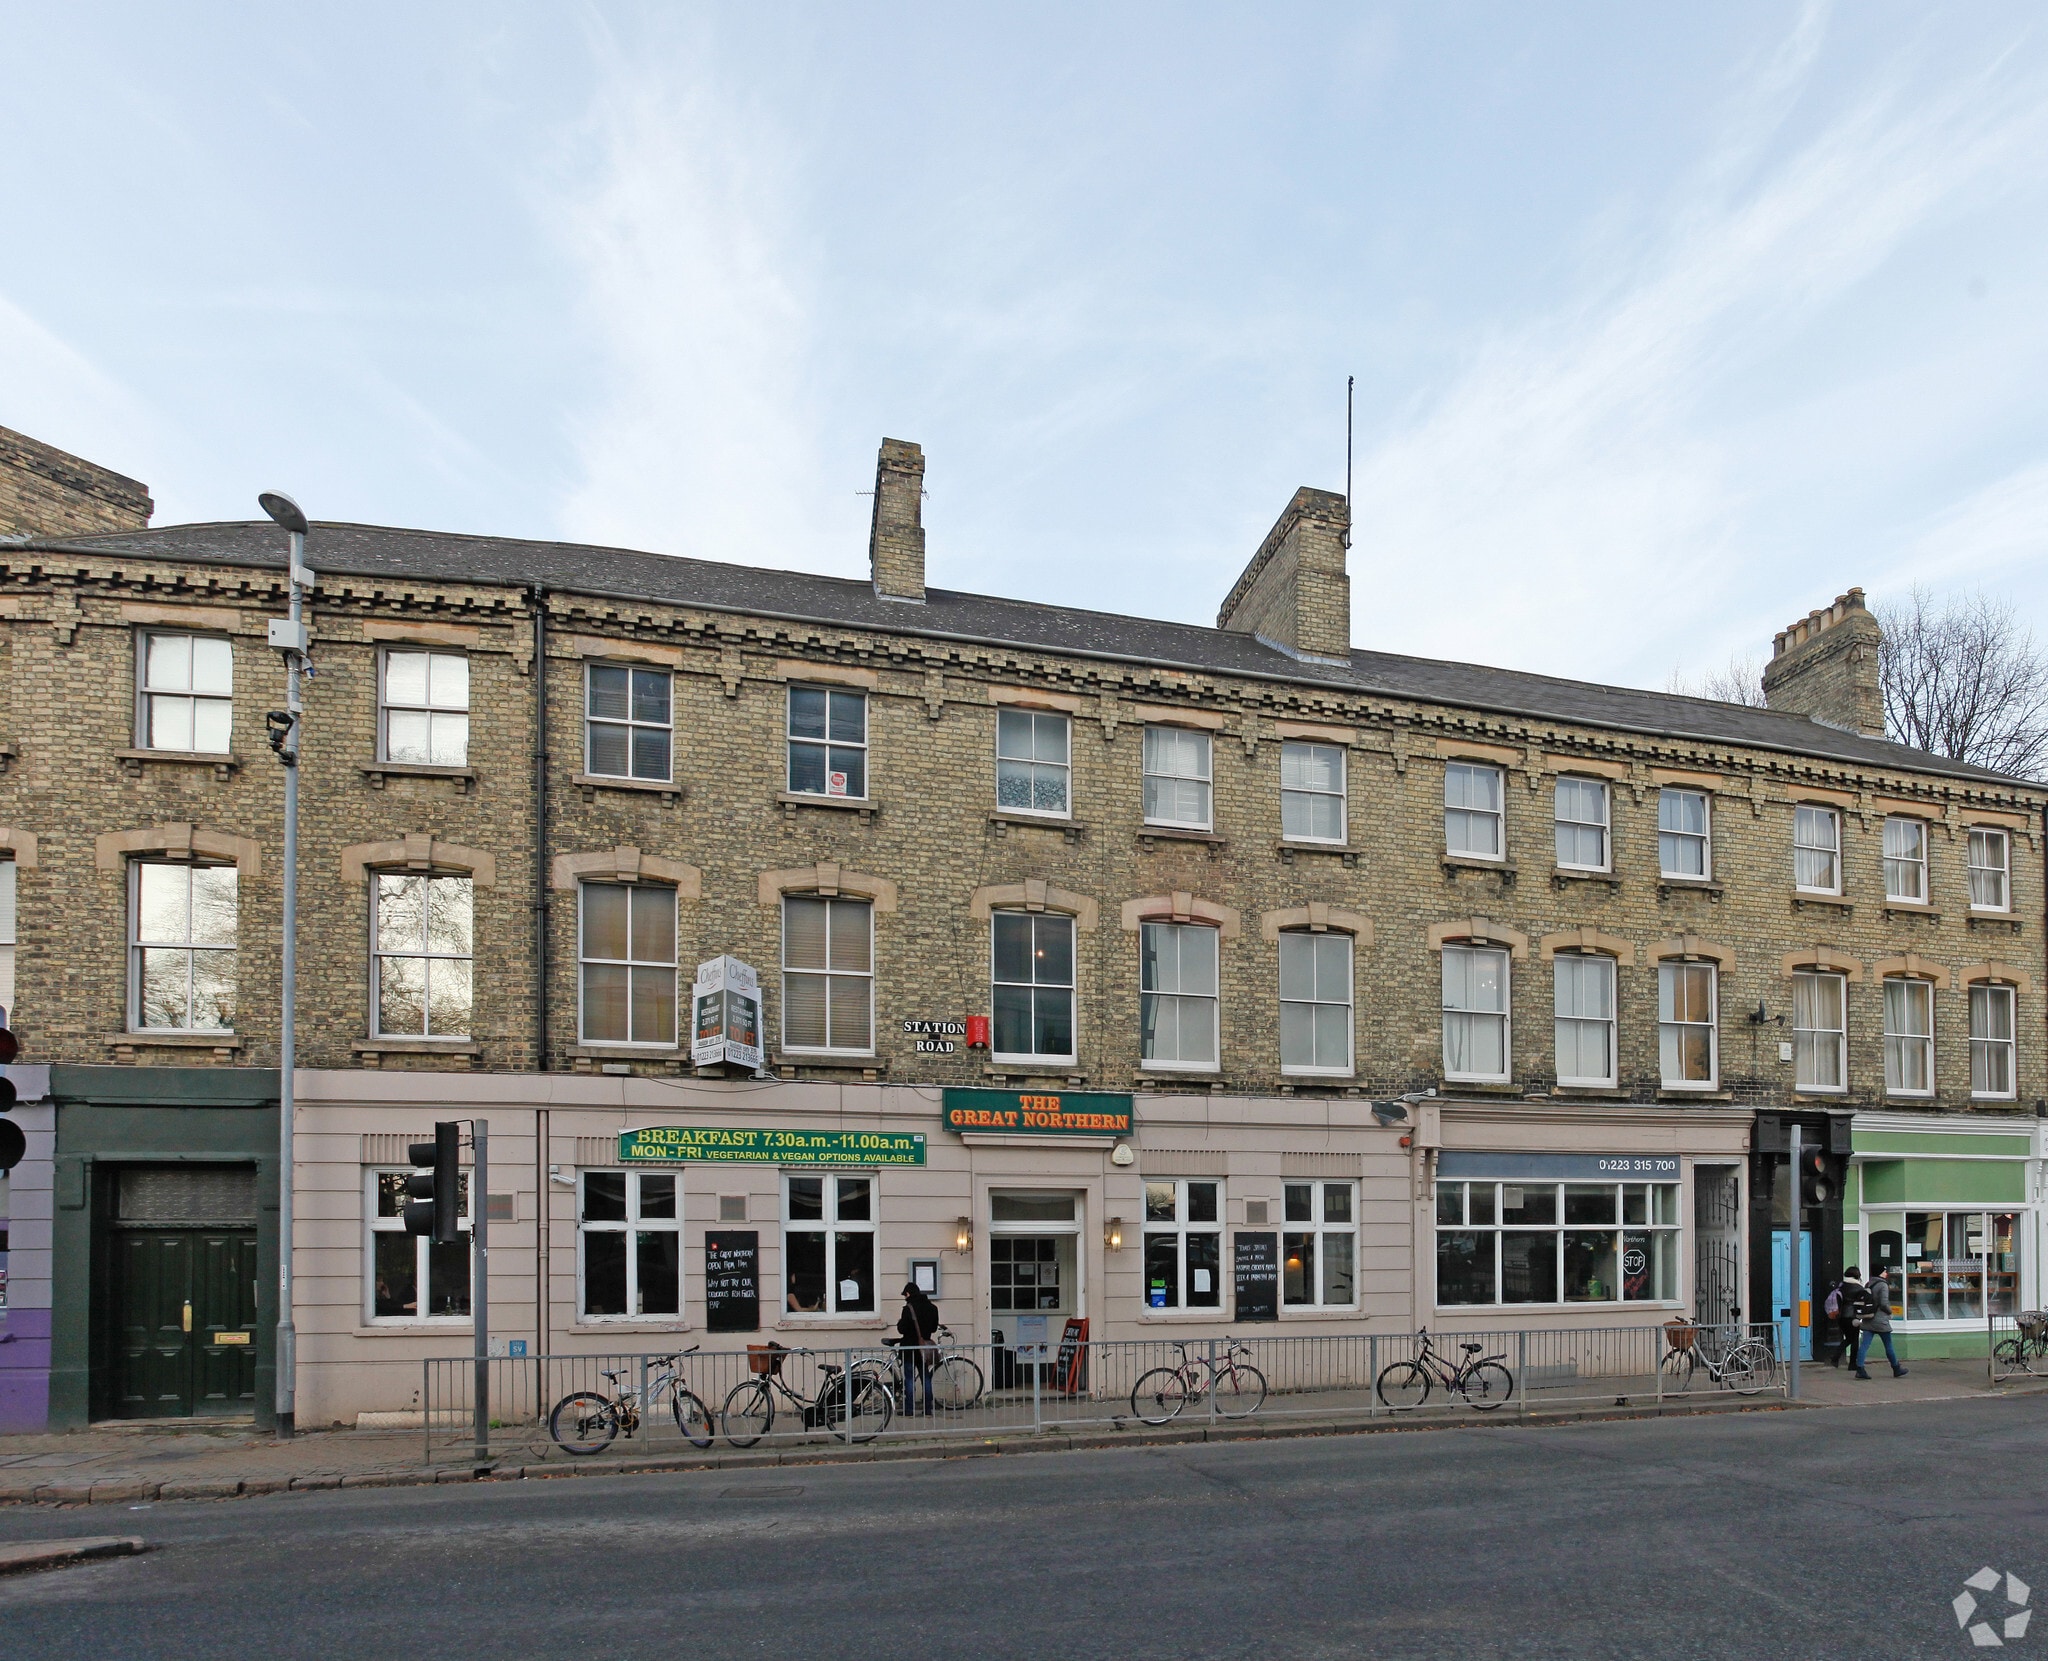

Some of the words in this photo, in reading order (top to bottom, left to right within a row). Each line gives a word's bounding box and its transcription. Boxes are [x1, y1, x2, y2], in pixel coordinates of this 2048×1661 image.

[729, 964, 754, 987] Cheffins
[904, 1021, 966, 1034] STATION
[729, 1025, 740, 1041] TO
[740, 1030, 755, 1045] LET
[916, 1040, 954, 1053] ROAD
[727, 1047, 742, 1060] 01223
[1019, 1095, 1060, 1111] THE
[950, 1109, 1018, 1127] GREAT
[1023, 1112, 1129, 1130] NORTHERN
[636, 1129, 757, 1146] BREAKFAST
[631, 1145, 667, 1158] MON
[677, 1146, 702, 1158] FRI
[706, 1150, 769, 1160] VEGETARIAN
[772, 1152, 780, 1160] &
[781, 1152, 815, 1161] VEGAN
[818, 1153, 861, 1162] OPTIONS
[863, 1154, 915, 1163] AVAILABLE
[1634, 1160, 1652, 1170] 315
[1655, 1160, 1675, 1171] 700
[708, 1251, 718, 1259] THE
[1624, 1256, 1643, 1267] STOP
[707, 1262, 721, 1270] OPEN
[707, 1279, 718, 1288] WHY
[720, 1279, 729, 1287] NOT
[731, 1278, 739, 1286] TRY
[742, 1278, 753, 1287] OUR
[512, 1345, 523, 1353] SV
